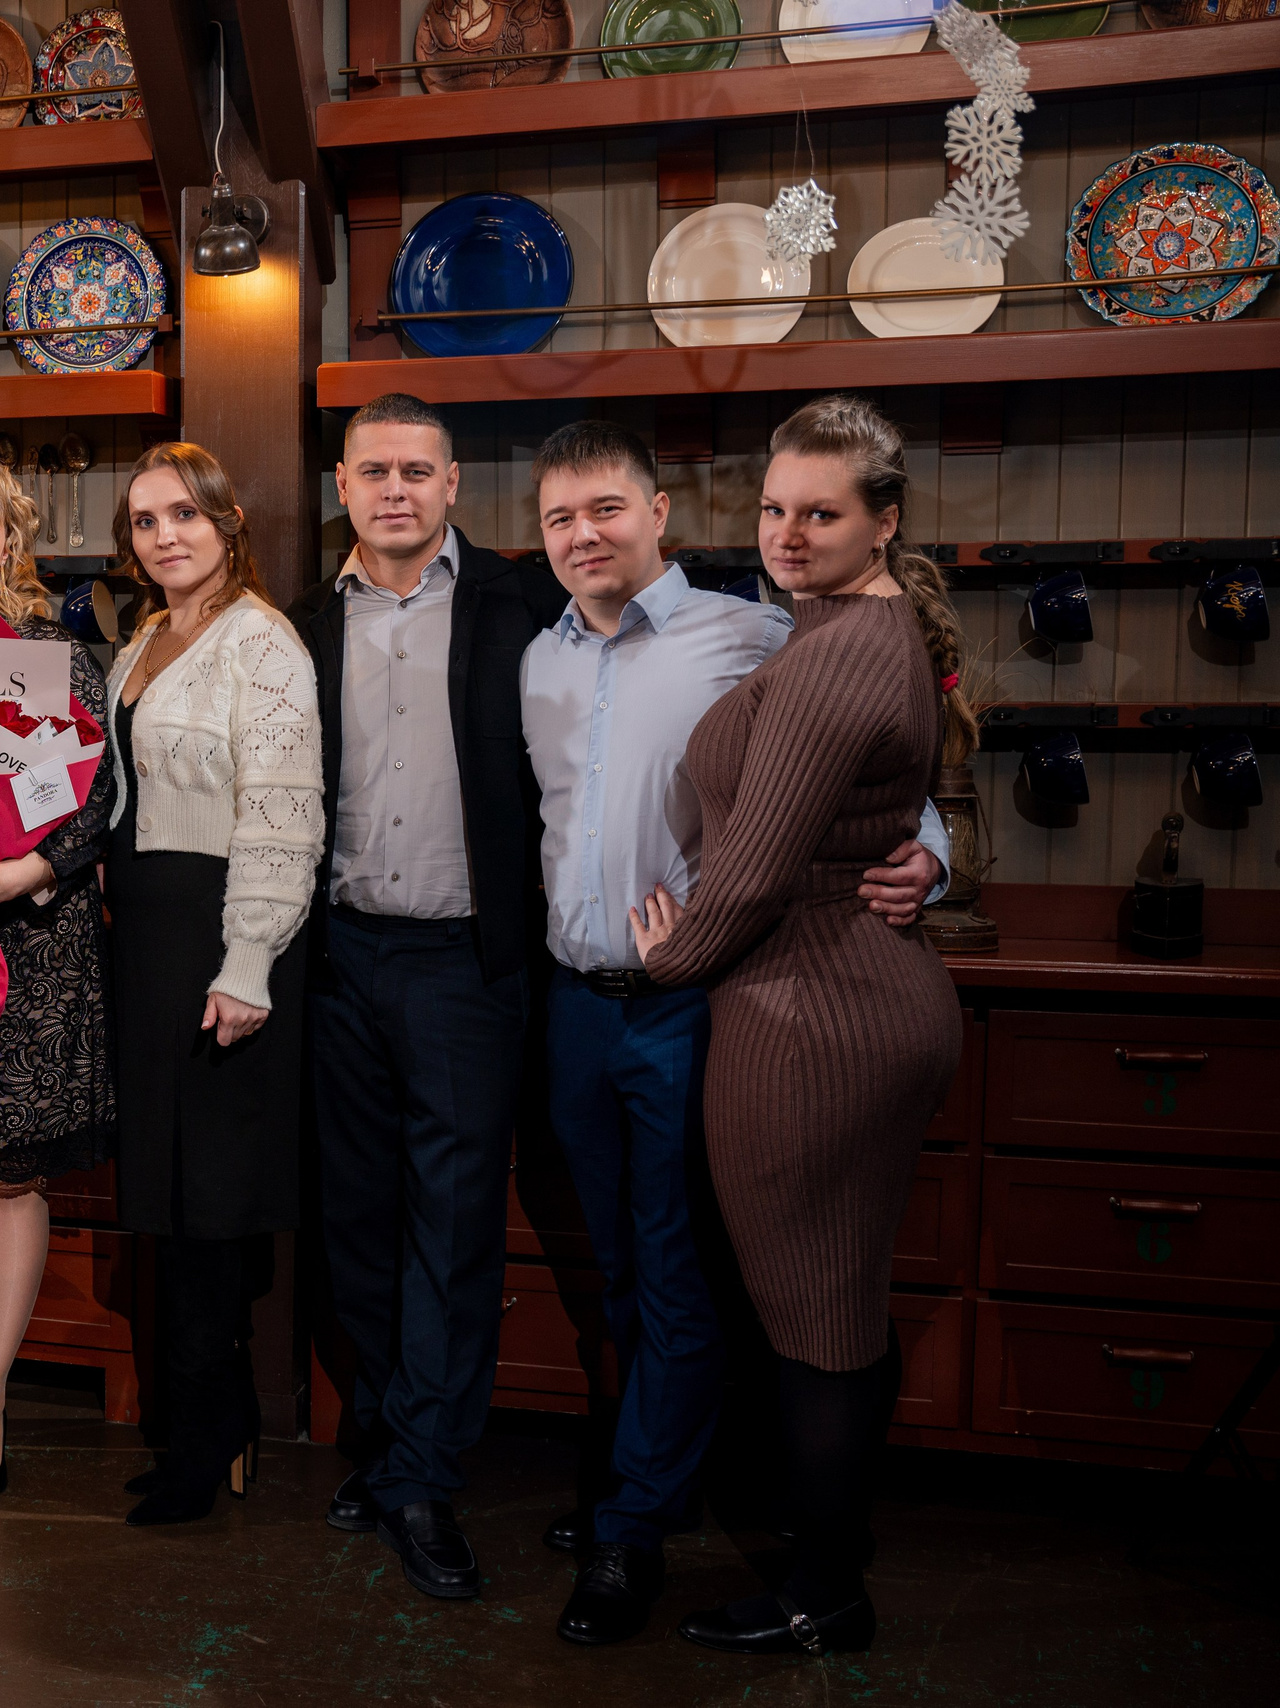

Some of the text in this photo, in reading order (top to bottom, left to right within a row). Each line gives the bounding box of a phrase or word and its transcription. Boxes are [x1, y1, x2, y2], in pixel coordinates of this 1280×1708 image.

[1143, 1073, 1178, 1116] 3
[1135, 1222, 1173, 1264] 6
[1129, 1369, 1165, 1411] 9
